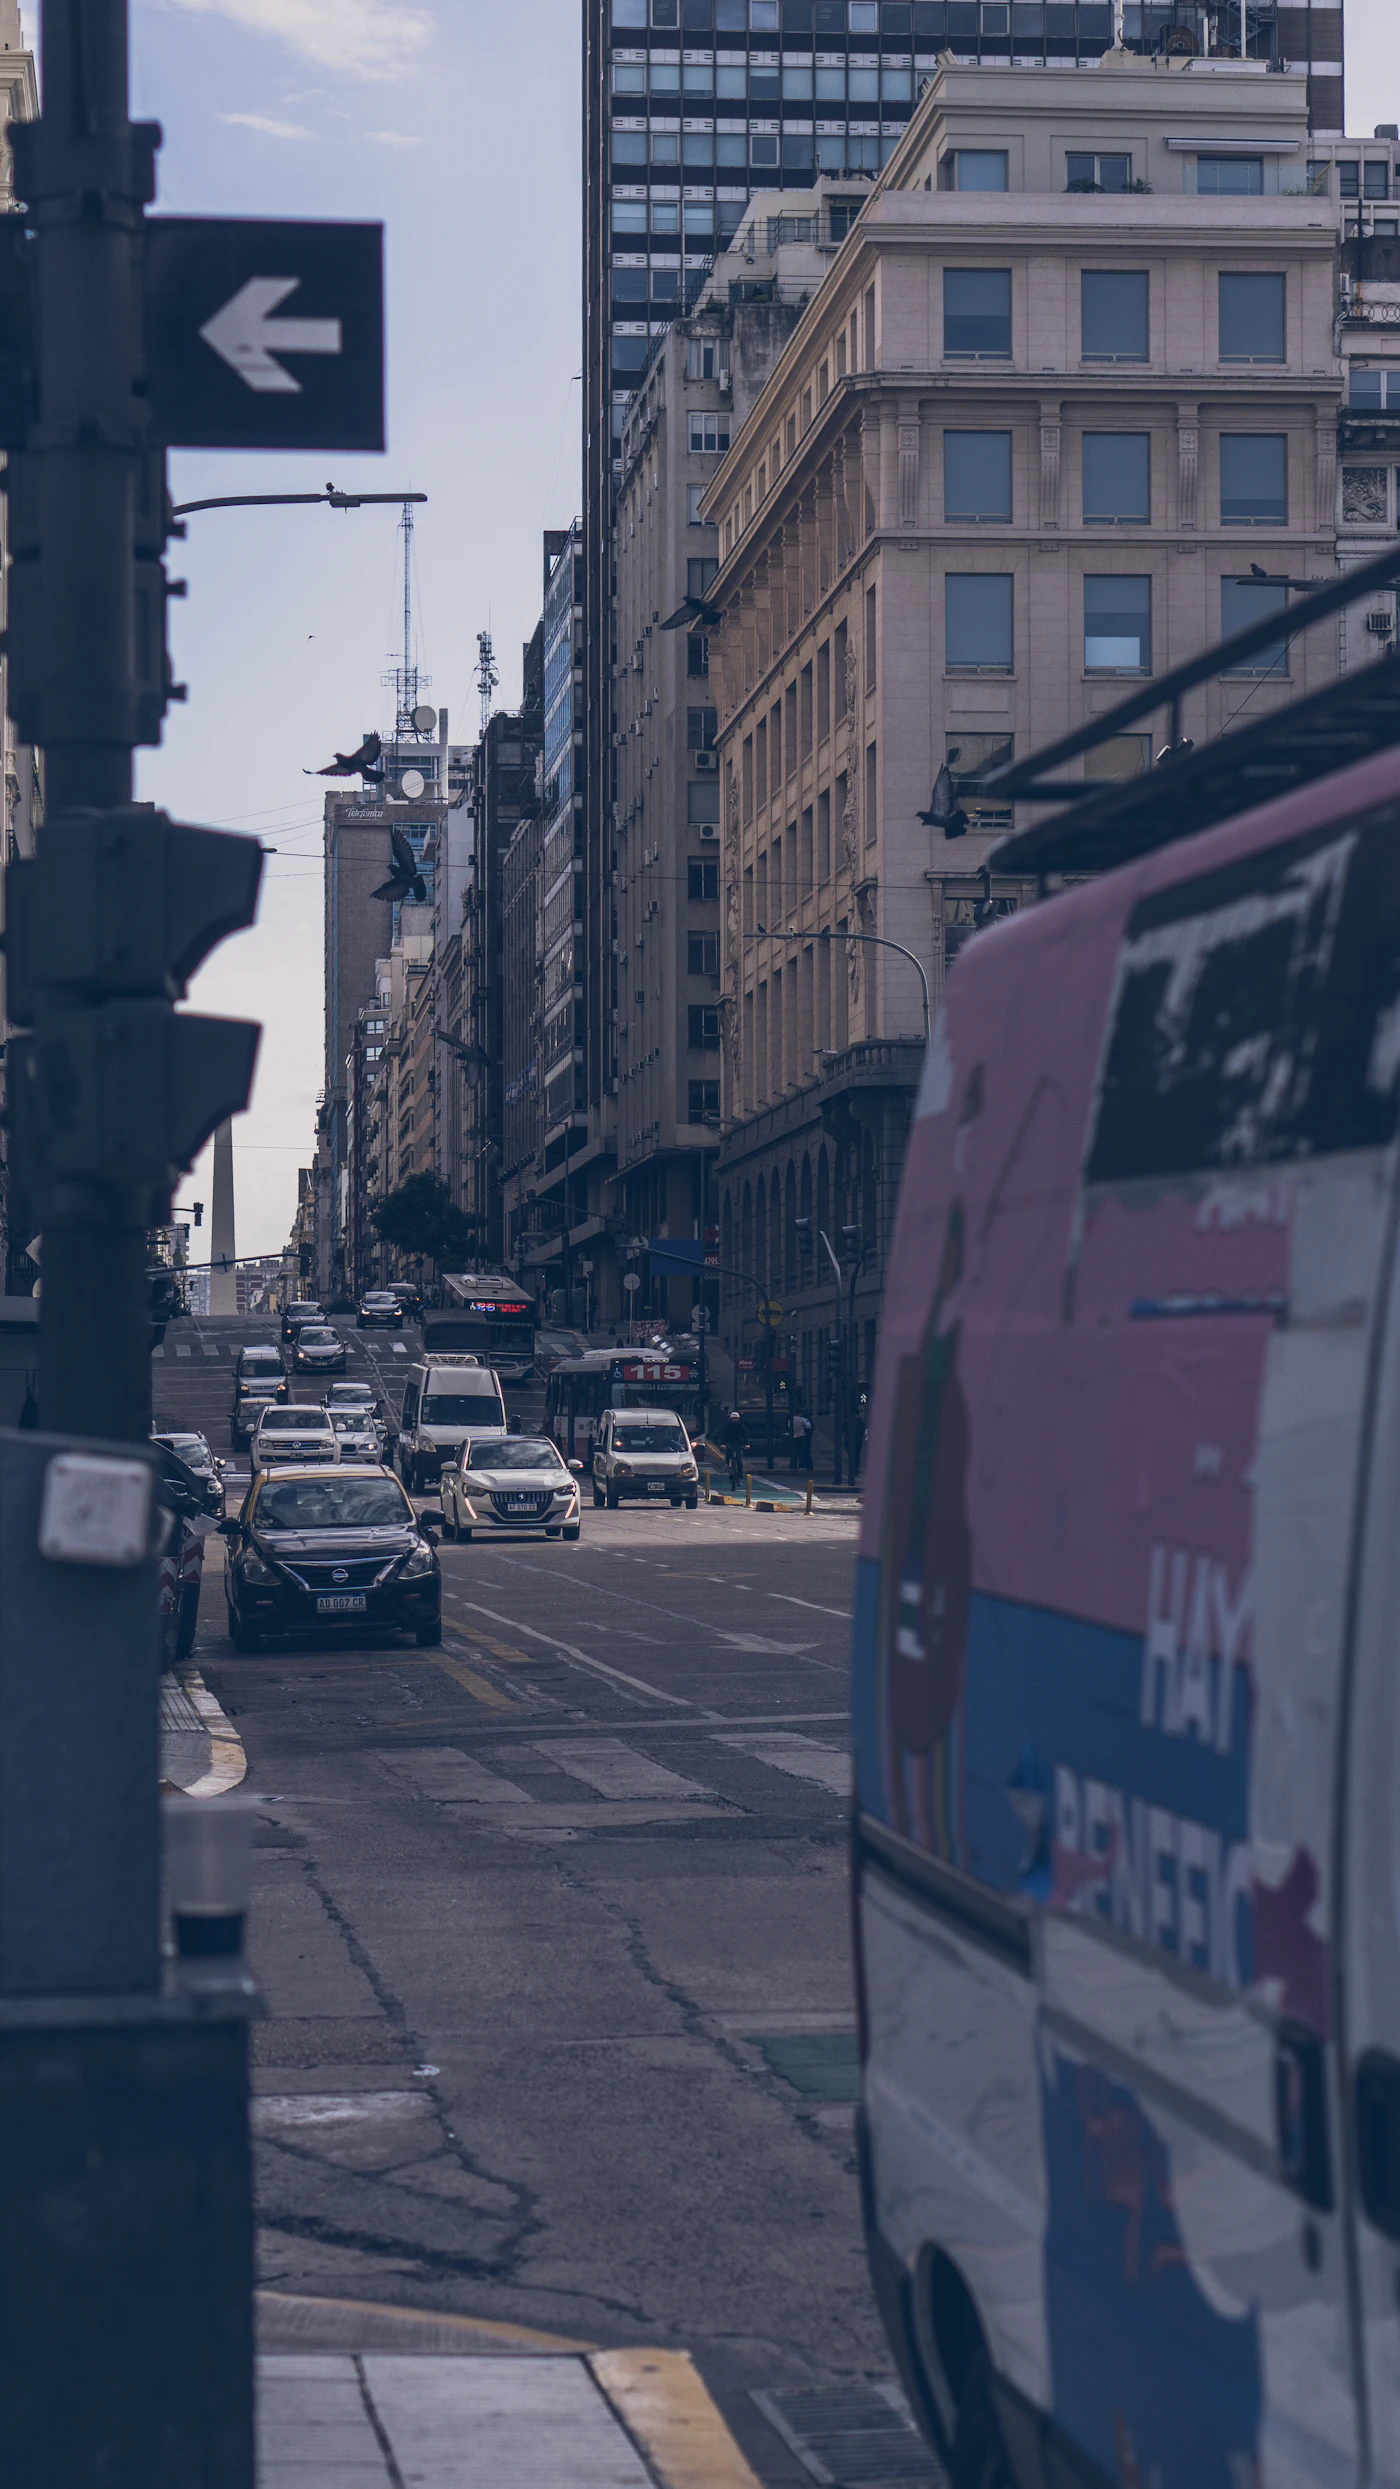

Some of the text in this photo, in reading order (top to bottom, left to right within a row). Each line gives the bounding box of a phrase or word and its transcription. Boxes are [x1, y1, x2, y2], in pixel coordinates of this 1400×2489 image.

[630, 1364, 682, 1380] 115
[319, 1597, 364, 1609] AD 007 CR
[1138, 1538, 1256, 1757] HAY
